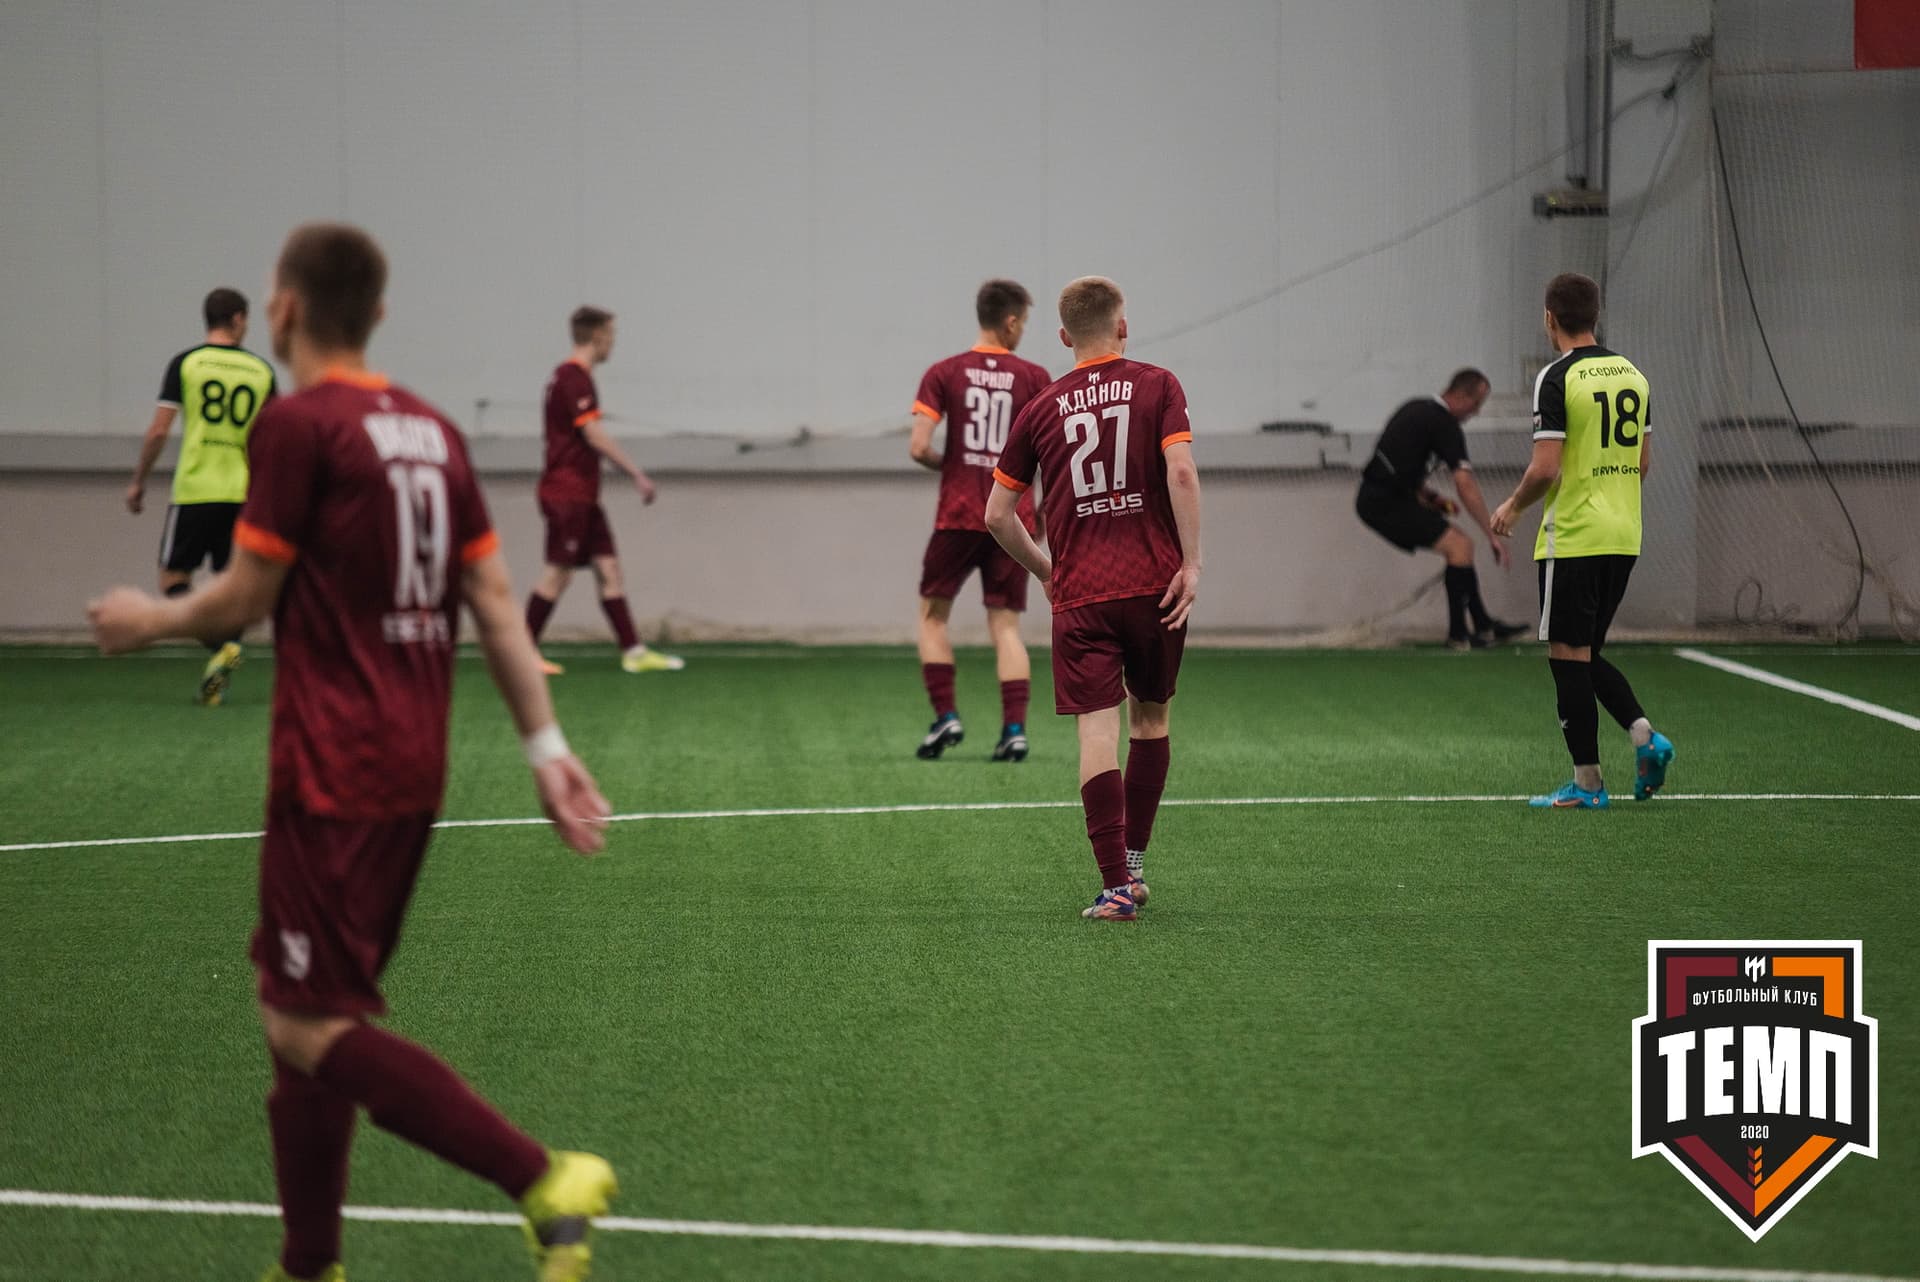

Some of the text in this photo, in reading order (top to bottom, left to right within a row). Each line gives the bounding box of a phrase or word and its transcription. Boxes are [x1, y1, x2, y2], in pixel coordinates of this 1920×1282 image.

[202, 380, 256, 427] 80
[964, 386, 1012, 453] 30
[1056, 380, 1133, 416] ЖДАНОВ
[1593, 388, 1640, 448] 18
[1064, 404, 1130, 498] 27
[1076, 493, 1143, 518] SEUS
[386, 463, 449, 609] 19
